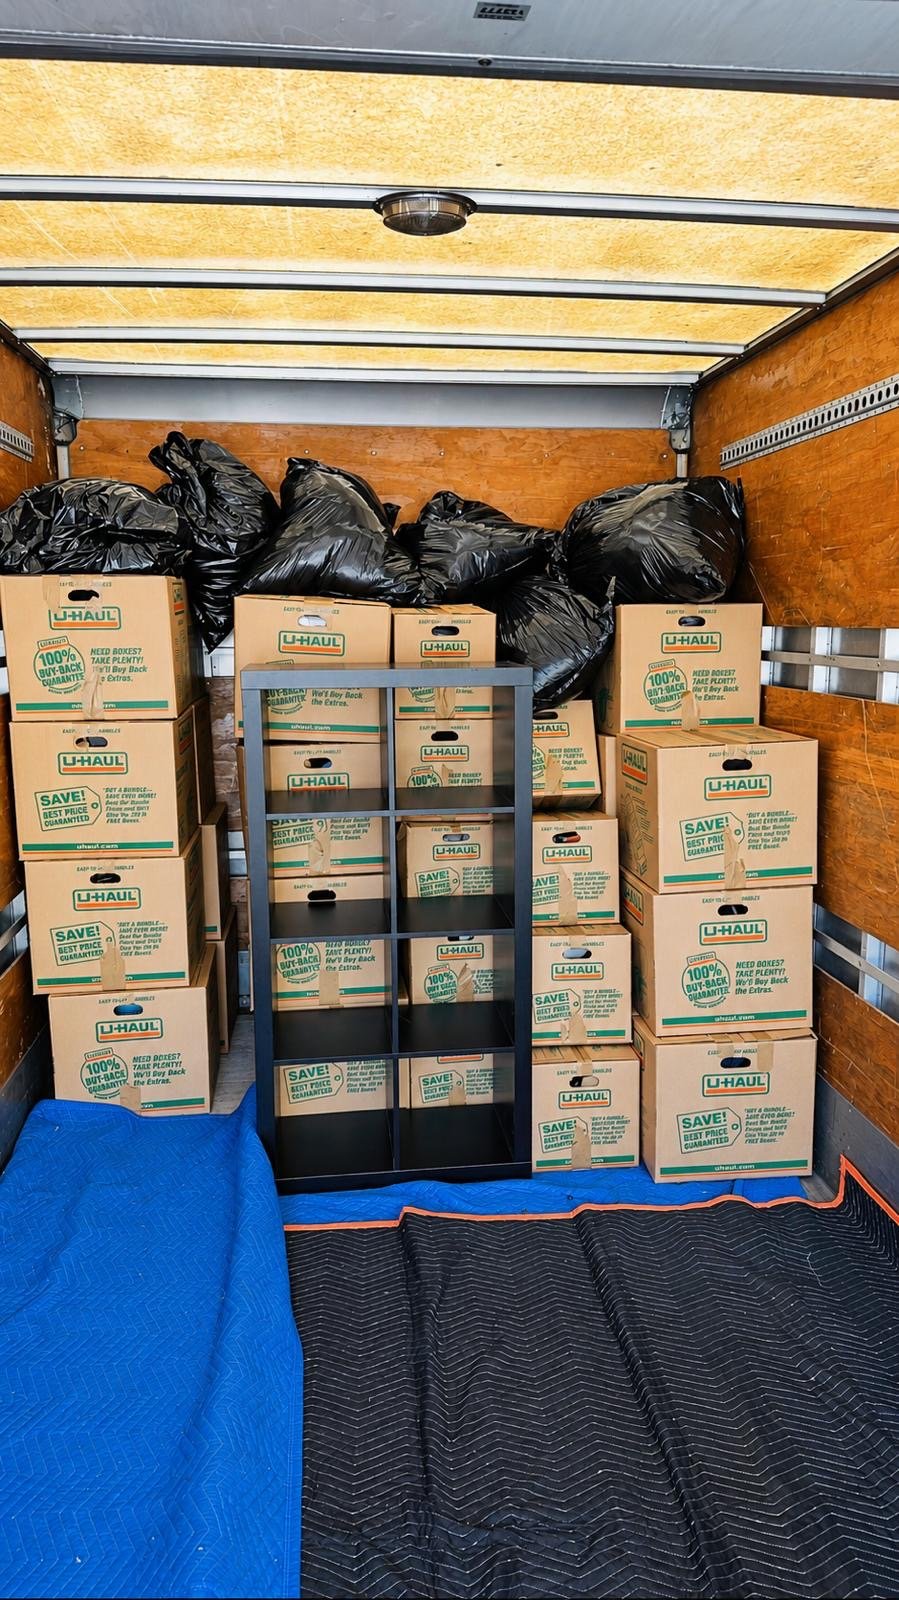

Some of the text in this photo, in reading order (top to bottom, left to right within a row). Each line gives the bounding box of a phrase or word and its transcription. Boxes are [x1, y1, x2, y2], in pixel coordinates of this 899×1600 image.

[54, 610, 117, 621] U-HAUL
[283, 634, 340, 647] U-HAUL
[665, 635, 717, 645] U-HAUL
[424, 643, 467, 651] U-HAUL
[39, 648, 77, 666] 100%
[39, 662, 82, 678] BUY-BACK
[112, 666, 126, 674] Buy
[648, 669, 680, 687] 100%
[424, 748, 467, 756] U-HAUL
[63, 755, 124, 766] U-HAUL
[291, 776, 346, 787] U-HAUL
[708, 778, 767, 792] U-HAUL
[40, 789, 86, 806] SAVE!
[42, 806, 89, 820] BEST PRICE
[684, 816, 729, 835] SAVE!
[686, 837, 705, 849] BEST
[436, 846, 478, 855] U-HAUL
[545, 848, 589, 858] U-HAUL
[534, 874, 560, 887] AVE!
[77, 891, 137, 903] U-HAUL
[55, 926, 100, 943] SAVE!
[704, 923, 763, 937] U-HAUL
[58, 941, 102, 955] BEST PRICE
[281, 943, 313, 960] 100%
[440, 945, 481, 954] U-HAUL
[554, 965, 600, 975] U-HAUL
[756, 959, 785, 968] BOXES?
[686, 963, 722, 981] 100%
[755, 968, 786, 976] PLENTY!
[686, 976, 728, 993] BUY-BACK
[735, 986, 774, 995] the Extras.
[535, 992, 569, 1005] SAVE!
[100, 1021, 159, 1035] U-HAUL
[86, 1057, 120, 1075] 100%
[288, 1064, 329, 1081] SAVE!
[133, 1079, 145, 1087] the
[422, 1073, 453, 1086] SAVE!
[707, 1075, 766, 1088] U-HAUL
[562, 1092, 608, 1103] U-HAUL
[542, 1119, 577, 1134] SAVE!
[682, 1111, 727, 1129] SAVE!
[683, 1127, 728, 1141] BEST PRICE
